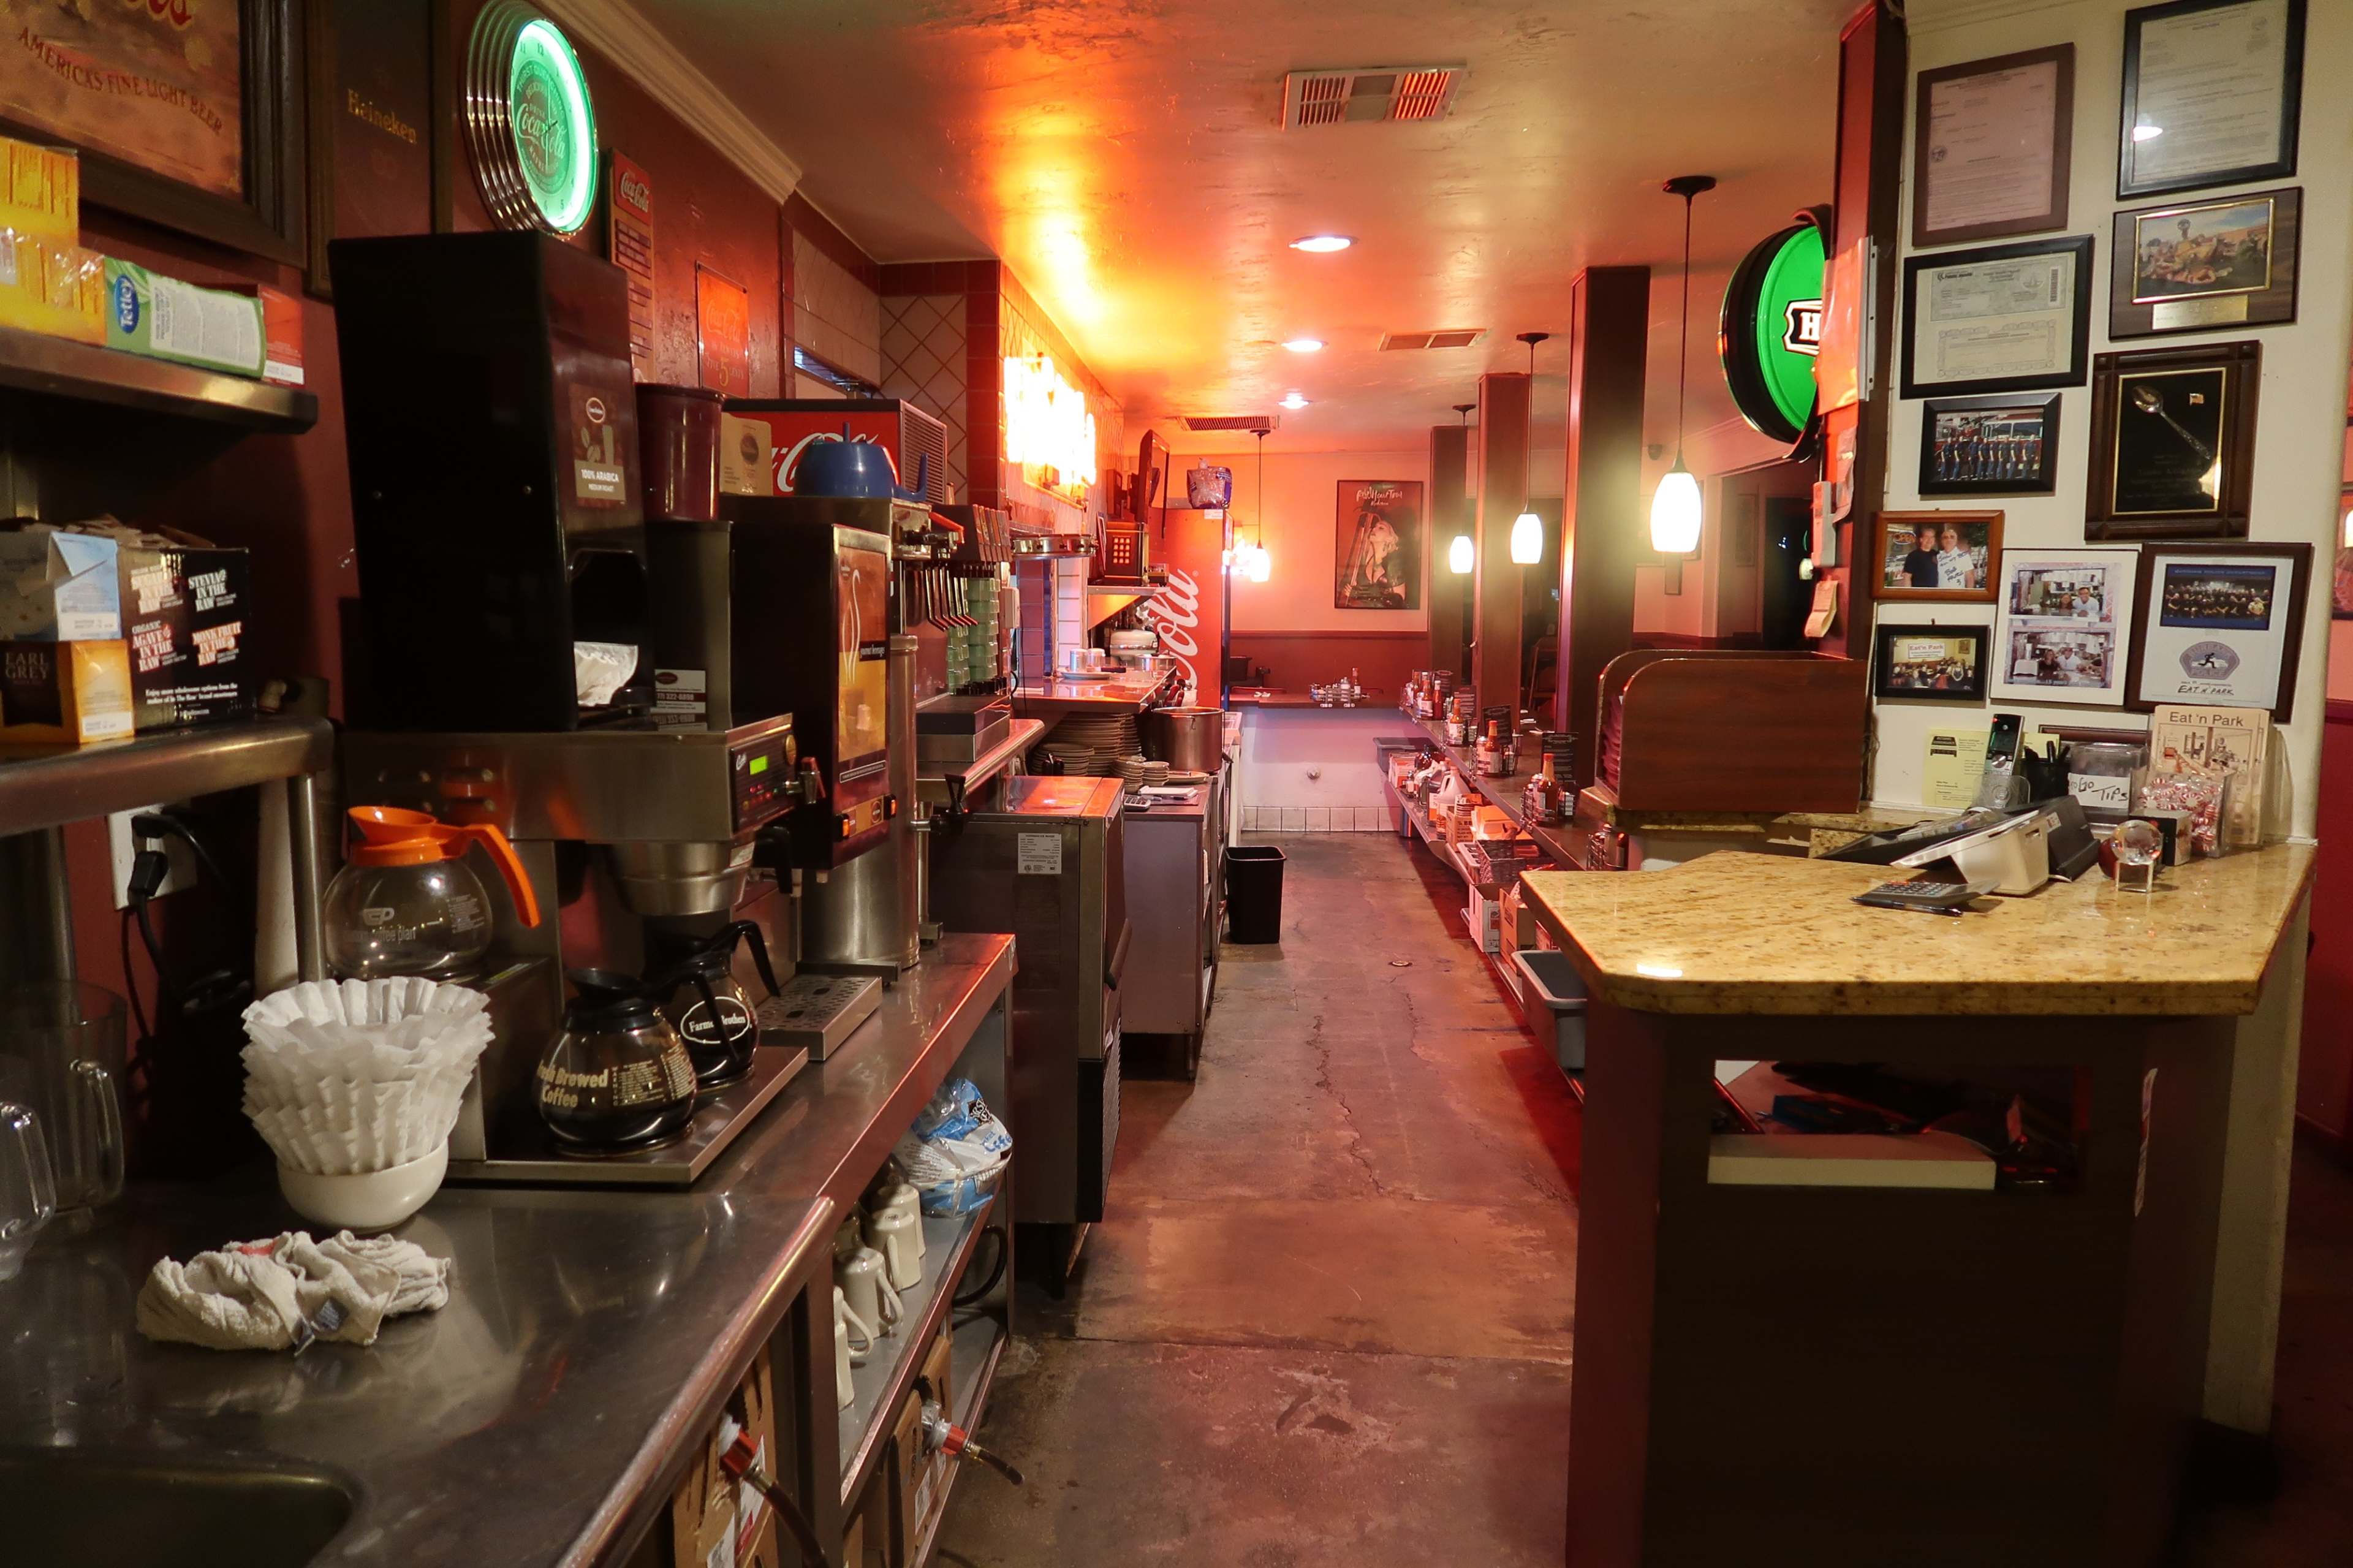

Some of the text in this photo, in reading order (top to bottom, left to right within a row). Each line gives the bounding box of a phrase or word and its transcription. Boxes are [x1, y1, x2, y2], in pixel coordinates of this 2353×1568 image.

[107, 74, 142, 96] FINE
[145, 78, 187, 107] LIGHT
[189, 96, 222, 136] BEER
[347, 88, 417, 145] Heineken
[119, 276, 135, 328] Tetley
[596, 471, 620, 483] ARABICA
[188, 572, 219, 589] STEVIA
[196, 582, 226, 599] IN THE
[195, 597, 214, 612] RAW
[132, 629, 164, 648] AGAVE
[140, 646, 152, 659] IN
[153, 639, 173, 656] THE
[5, 662, 50, 680] GREY
[138, 656, 160, 673] RAW
[2178, 684, 2199, 694] EAT
[2210, 687, 2235, 696] PARK
[2170, 711, 2192, 723] Eat
[2212, 714, 2245, 727] Park
[689, 1021, 714, 1033] Farme
[555, 1067, 608, 1088] Brewed
[542, 1085, 578, 1108] Coffee
